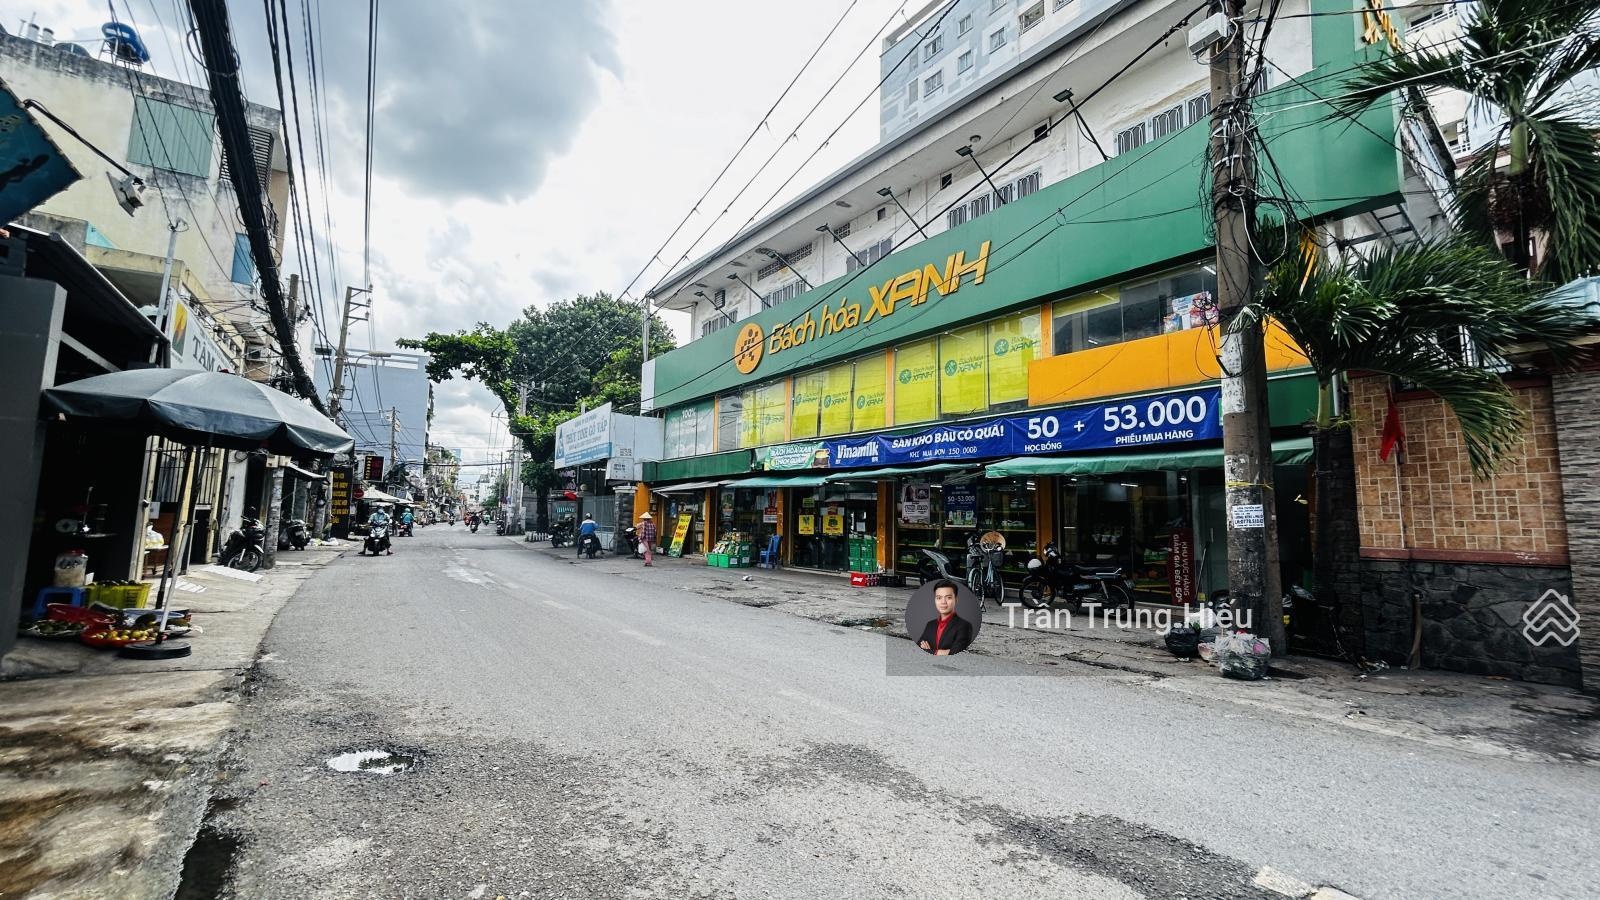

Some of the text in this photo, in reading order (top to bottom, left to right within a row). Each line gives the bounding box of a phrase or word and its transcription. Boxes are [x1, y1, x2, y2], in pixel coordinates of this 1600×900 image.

[768, 240, 993, 355] Bách hóa XANH
[912, 370, 935, 381] XANH
[957, 362, 982, 373] XANH
[1027, 416, 1059, 440] 50
[1103, 395, 1207, 431] 53.000
[911, 433, 932, 446] KHO
[957, 425, 973, 441] CÓ
[1115, 429, 1194, 444] PHIẾU MUA HÀNG
[837, 441, 879, 459] Vinamilk
[948, 447, 960, 455] 150
[1024, 444, 1041, 453] HỌC
[1183, 575, 1191, 597] HÀNG
